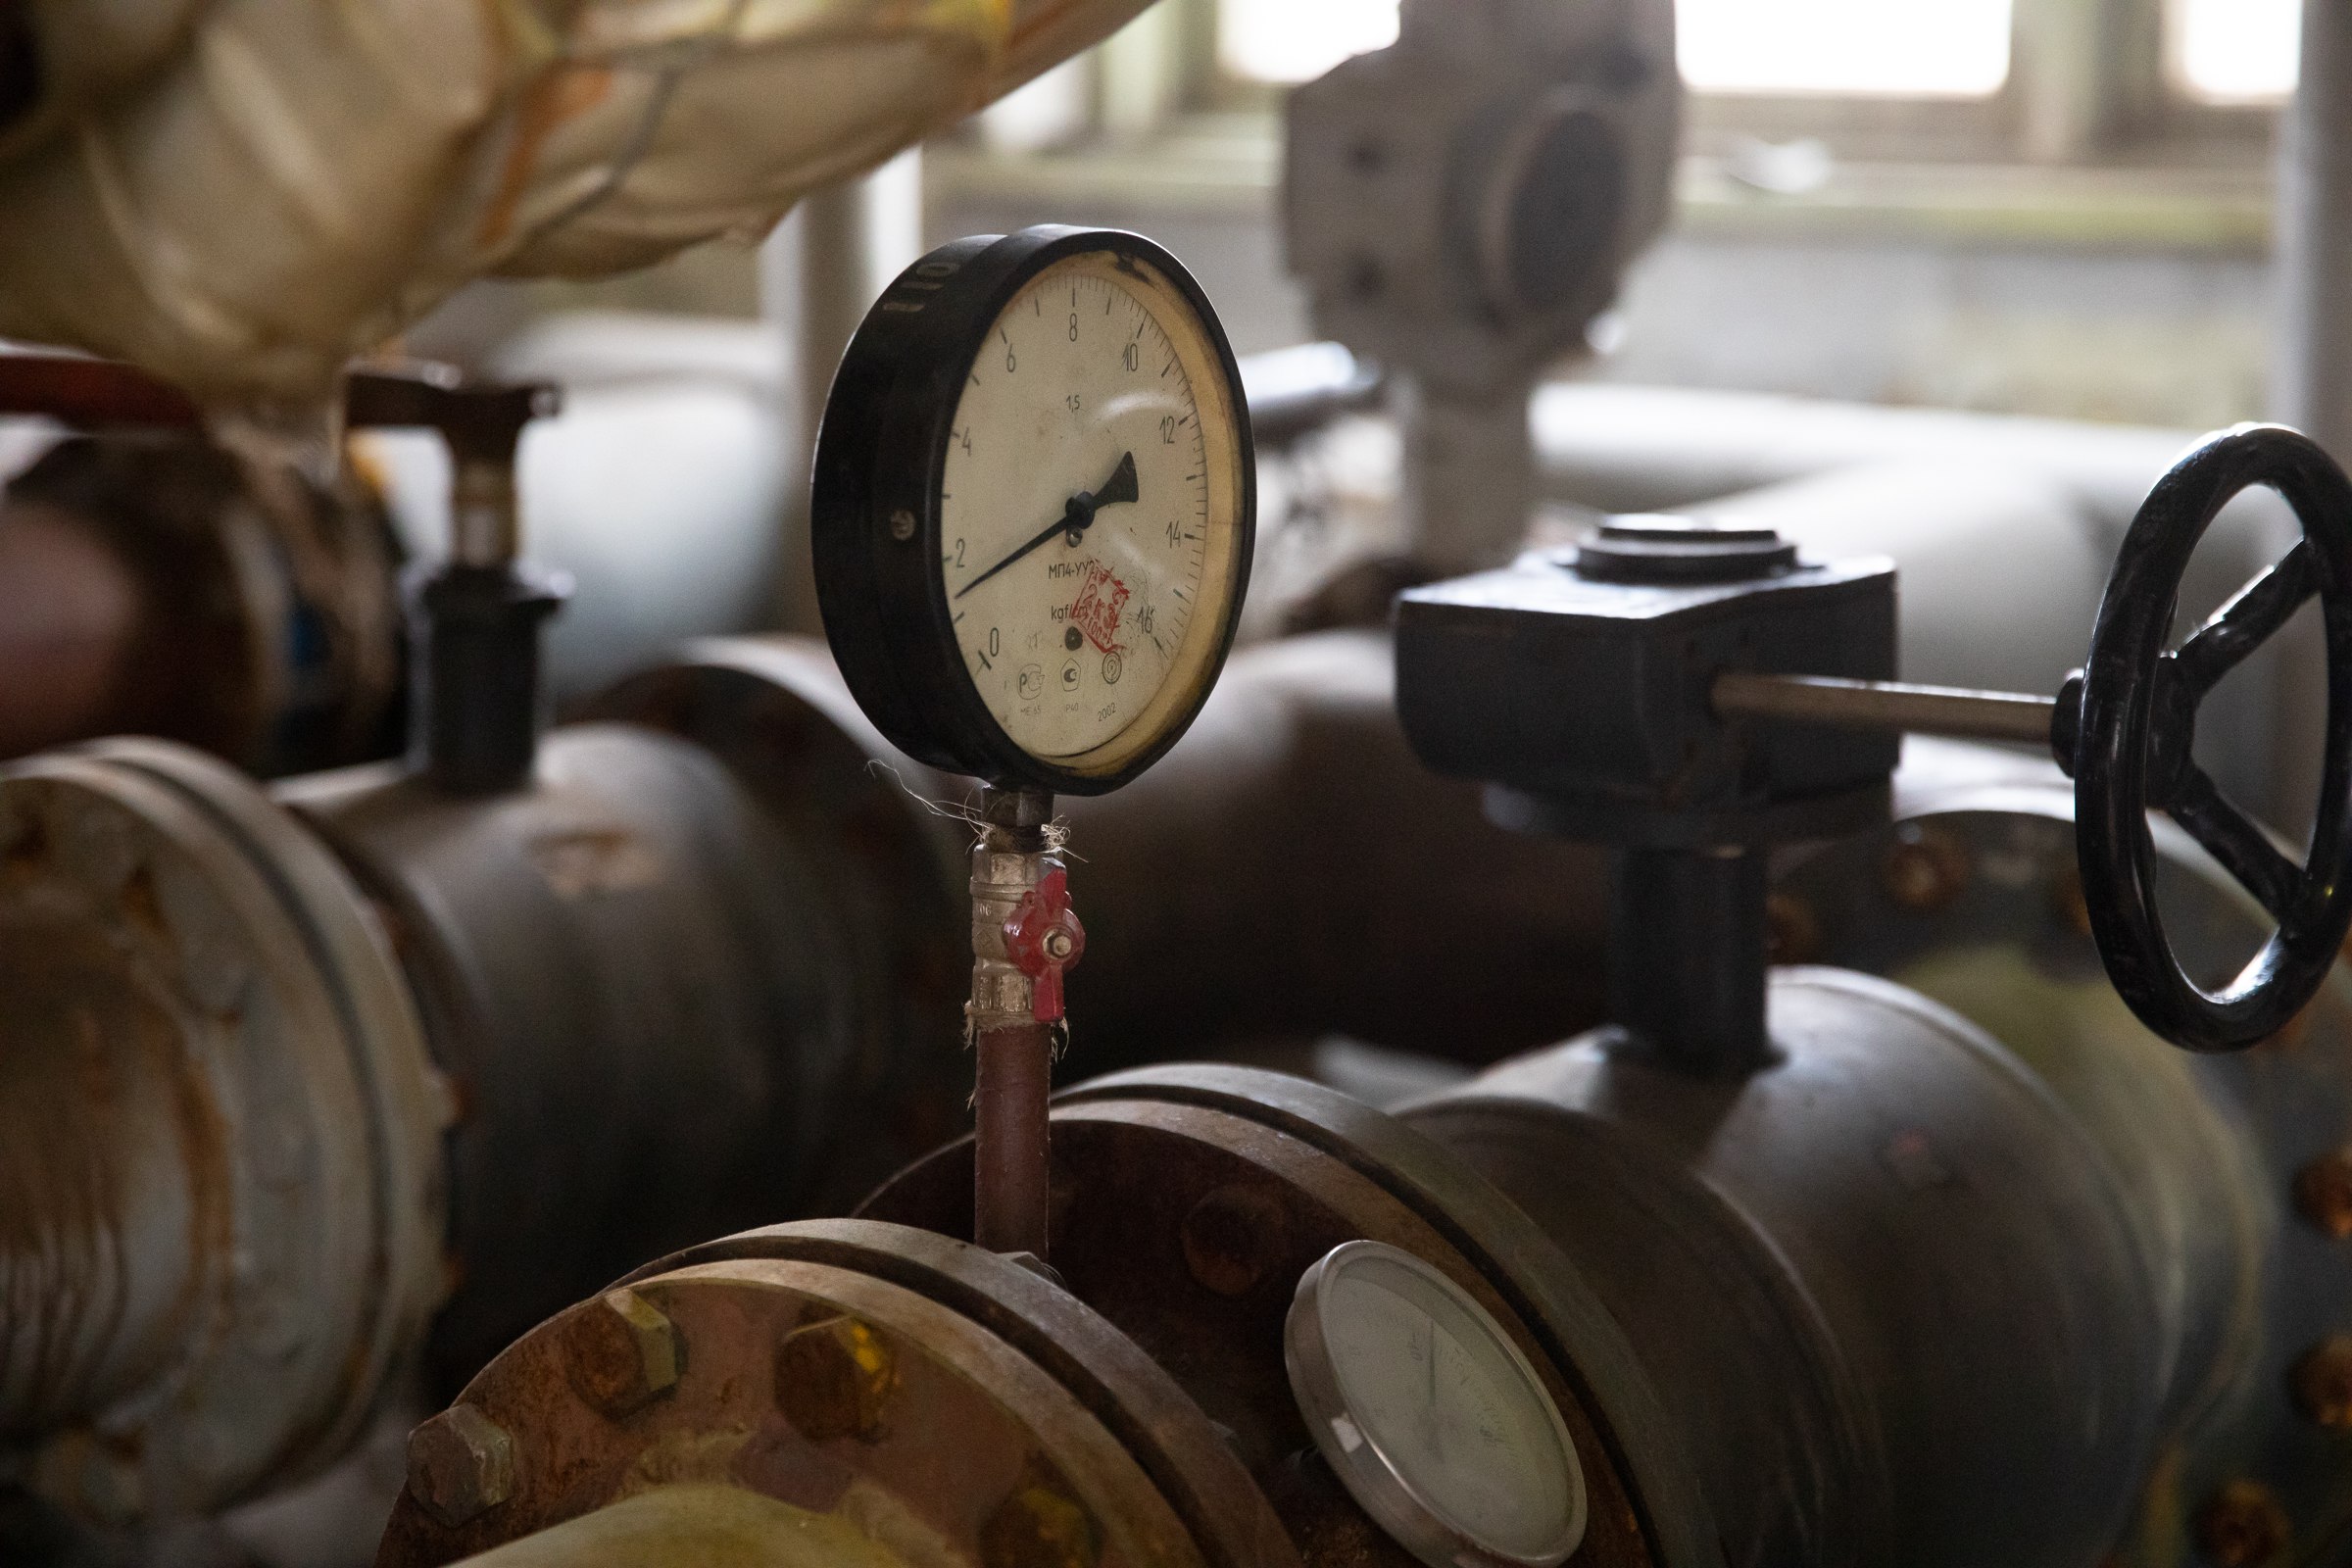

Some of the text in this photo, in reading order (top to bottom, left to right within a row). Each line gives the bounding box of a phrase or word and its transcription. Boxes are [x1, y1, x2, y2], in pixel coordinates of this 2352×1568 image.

[1068, 313, 1079, 343] 8
[1005, 342, 1017, 373] 6
[1122, 342, 1139, 372] 10
[961, 427, 972, 458] 4
[1160, 416, 1176, 446] 12
[1166, 520, 1182, 549] 14
[956, 538, 966, 568] 2
[1137, 606, 1154, 635] 16
[988, 627, 1000, 658] 0
[1097, 702, 1117, 722] 2002
